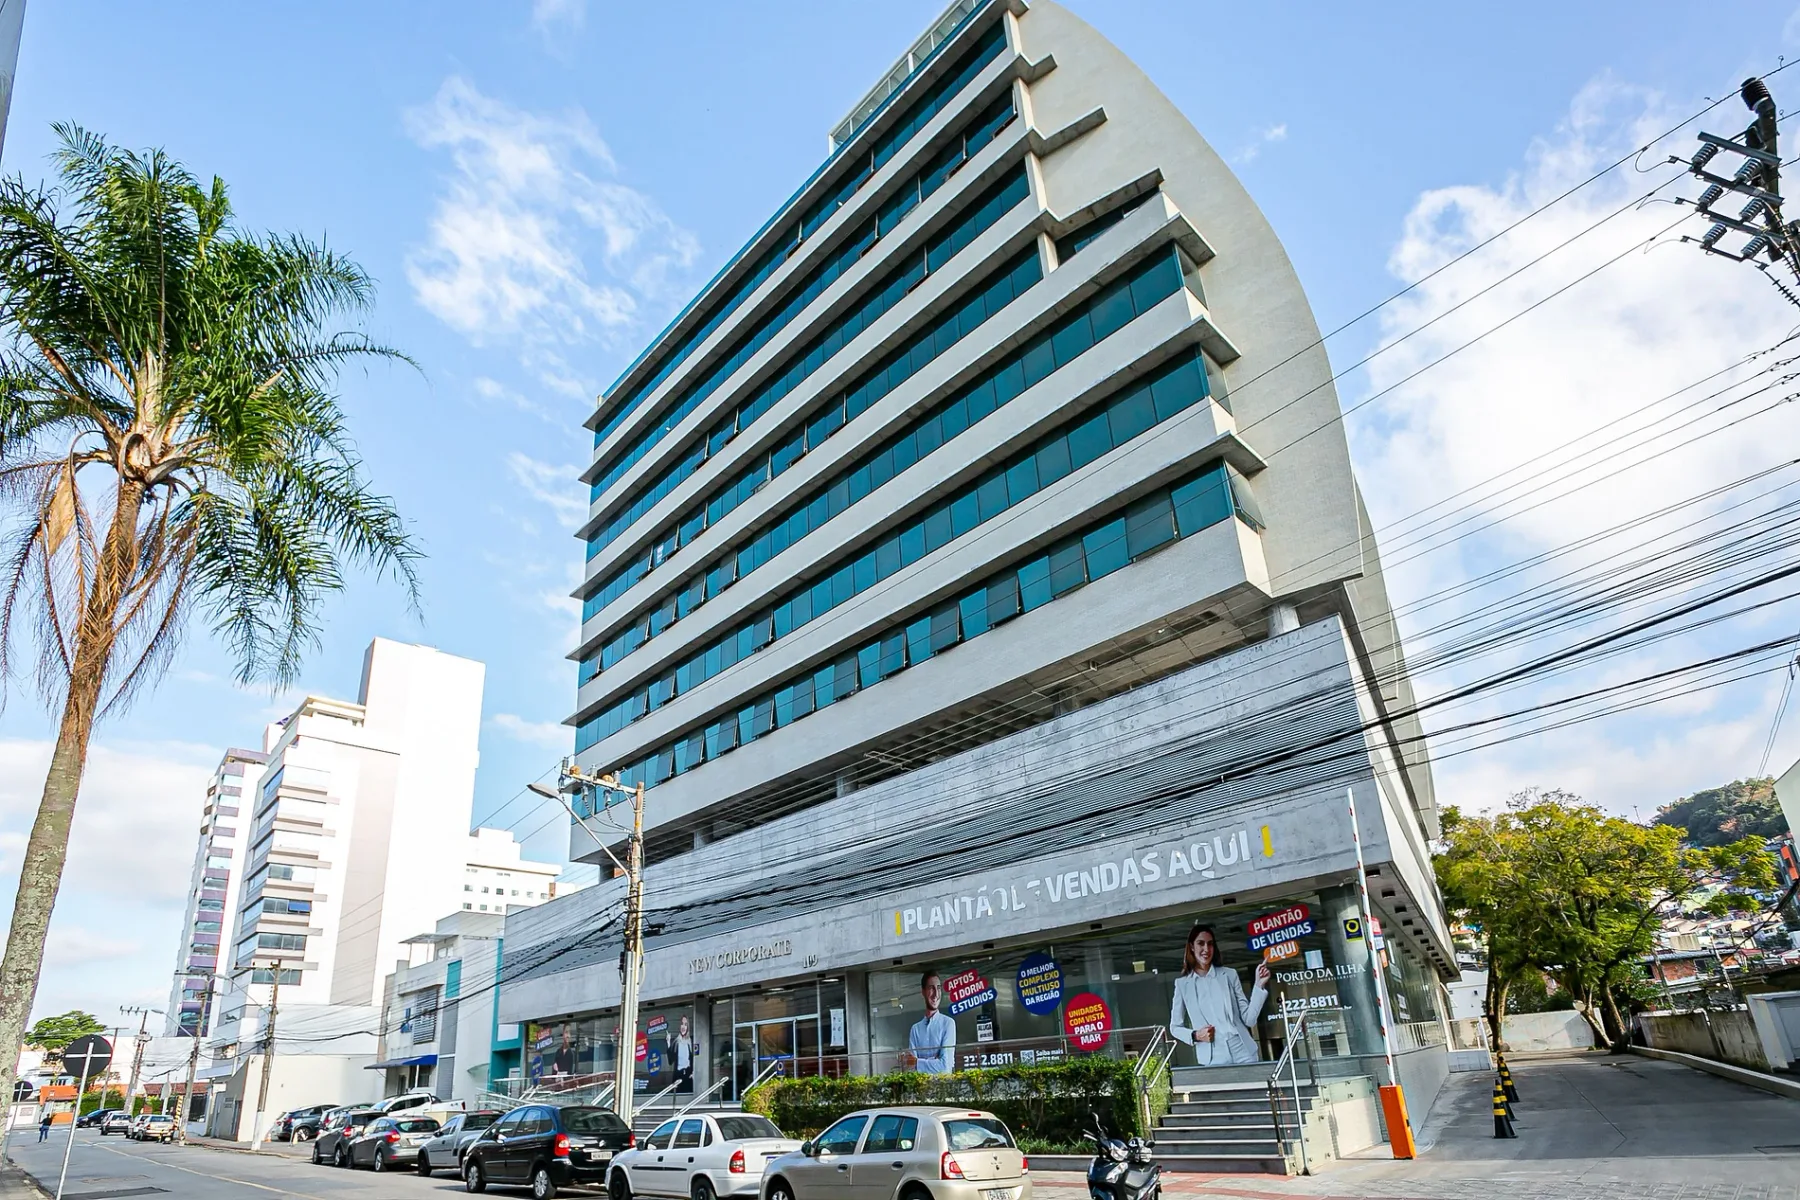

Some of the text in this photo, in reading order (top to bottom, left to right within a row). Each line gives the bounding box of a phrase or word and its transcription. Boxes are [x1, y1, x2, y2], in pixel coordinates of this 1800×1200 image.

[1044, 851, 1161, 903] VENDAS
[1168, 830, 1250, 878] AQUI
[1253, 908, 1303, 934] PLANTÃO
[1252, 922, 1312, 950] DE VENDAS
[688, 939, 792, 975] NEW CORPORATE
[1270, 941, 1297, 959] AQUI
[1026, 962, 1055, 976] MELHOR
[1276, 963, 1366, 983] PORTO DA ILHA
[948, 972, 975, 991] APTOS
[1019, 970, 1059, 988] COMPLEXO
[953, 981, 985, 1001] 1 DORM
[1021, 980, 1060, 997] MULTIUSO
[951, 990, 994, 1014] E STUDIOS
[1025, 990, 1060, 1006] DA REGIÃO
[1279, 994, 1339, 1012] 222.8811
[1068, 1003, 1103, 1018] UNIDADES
[1069, 1012, 1105, 1027] COM VISTA
[1074, 1021, 1104, 1035] PARA O
[1080, 1033, 1102, 1045] MAR
